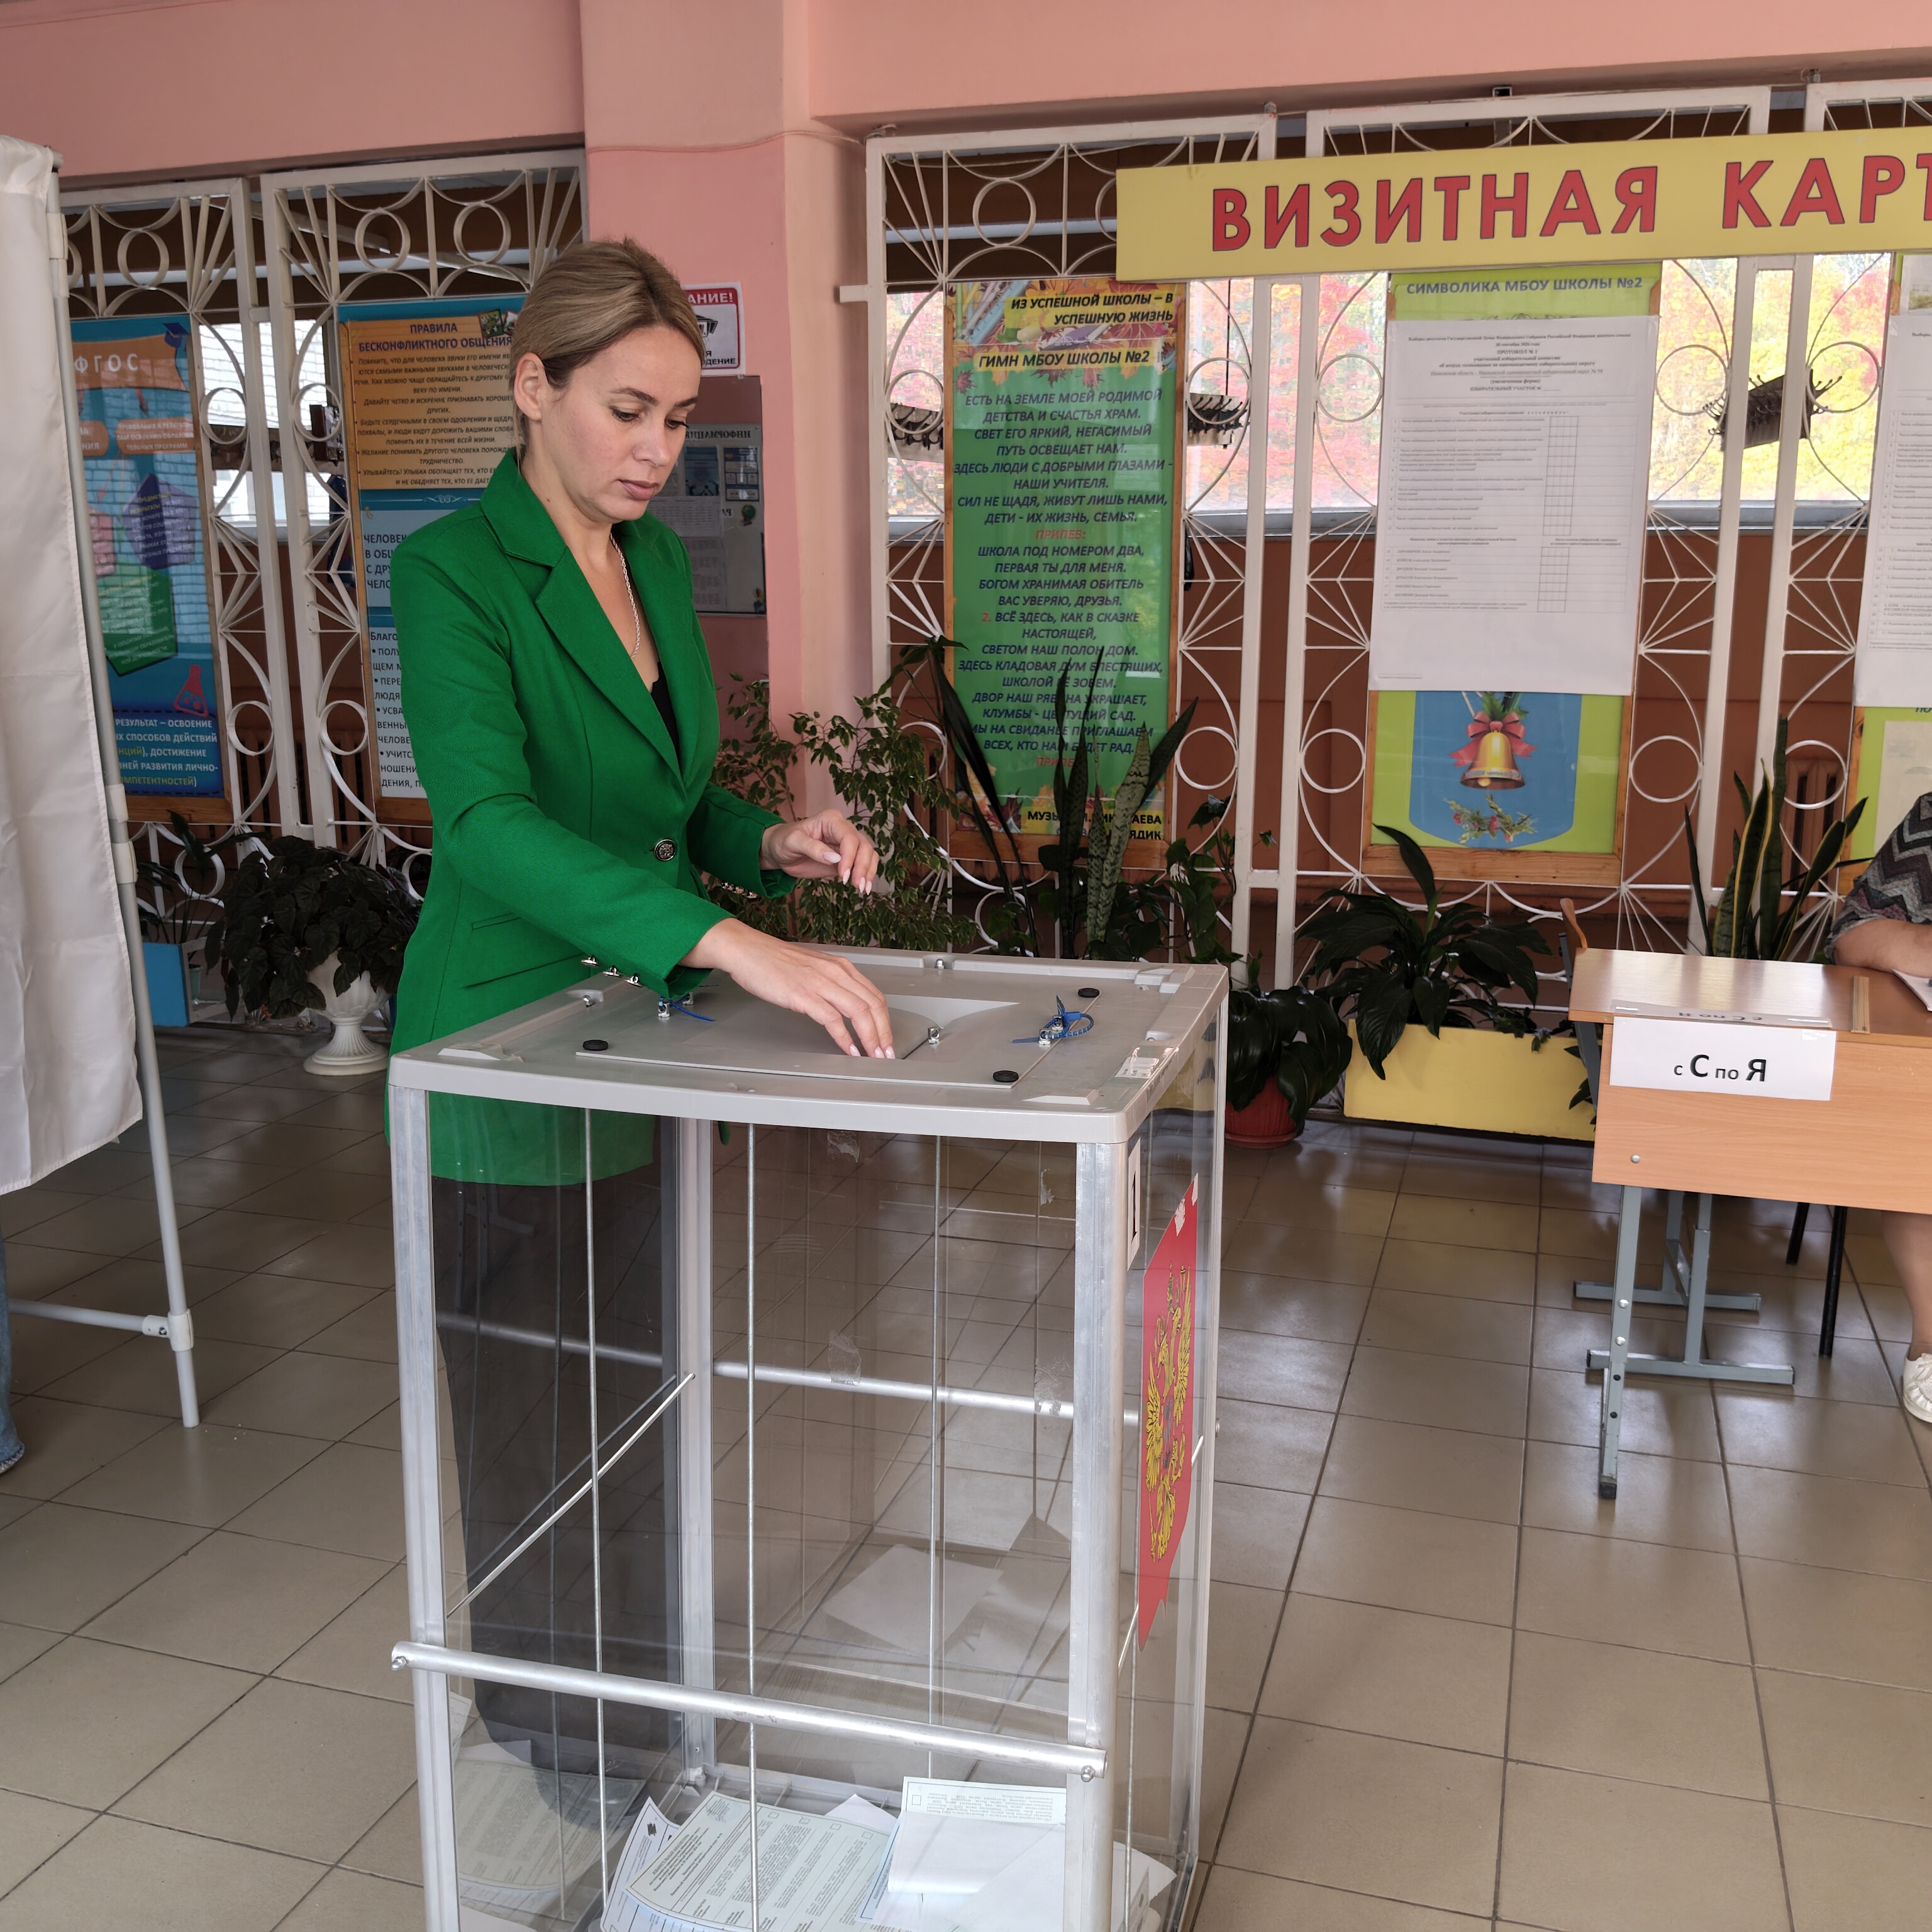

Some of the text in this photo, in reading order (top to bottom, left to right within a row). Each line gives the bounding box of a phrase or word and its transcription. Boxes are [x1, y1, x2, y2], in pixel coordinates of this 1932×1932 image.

[1212, 166, 1658, 252] ВИЗИТНАЯ
[1406, 277, 1643, 294] СИМВОЛИКА МБОУ ШКОЛЫ №2
[688, 292, 733, 304] АНИЕ!
[1011, 292, 1174, 309] ИЗ УСПЕШНОЙ ШКОЛЫ В
[1054, 310, 1174, 325] УСПЕШНУЮ ЖИЗНЬ
[410, 323, 458, 333] ПРАВИЛА
[358, 336, 512, 352] БЕСКОНФЛИКТНОГО ОБЩЕНИЯ
[979, 350, 1150, 369] ГИМН МБОУ ШКОЛЫ №2
[965, 389, 1162, 406] ЕСТЬ НА ЗЕМЛЕ МОЕЙ РОДИМОЙ
[982, 408, 1141, 424] ДЕТСТВА И СЧАСТЬЯ ХРАМ.
[974, 423, 1152, 440] СВЕТ ЕГО ЯРКИЙ, НЕГАСИМЫЙ
[996, 443, 1127, 457] ПУТЬ ОСВЕЩАЕТ НАМ.
[953, 460, 1165, 475] ЗДЕСЬ ЛЮДИ С ДОБРЫМИ ГЛАЗАМИ
[1013, 478, 1109, 489] НАШИ УЧИТЕЛЯ.
[957, 494, 1168, 508] СИЛ НЕ ЩАДЯ, ЖИВУТ ЛИШЬ НАМИ,
[984, 511, 1137, 525] ДЕТИ ИХ ЖИЗНЬ, СЕМЬЯ.
[365, 550, 371, 558] В
[977, 545, 1145, 558] ШКОЛА ПОД НОМЕРОМ ДВА,
[994, 563, 1126, 574] ПЕРВАЯ ТЫ ДЛЯ МЕНЯ.
[979, 579, 1144, 590] БОГОМ ХРАНИМАЯ ОБИТЕЛЬ
[998, 596, 1123, 608] ВАС УВЕРЯЮ, ДРУЗЬЯ.
[995, 611, 1017, 623] ВСЁ
[1018, 612, 1057, 625] ЗДЕСЬ,
[1060, 613, 1083, 623] КАК
[1086, 613, 1094, 623] В
[1097, 613, 1140, 623] СКАЗКЕ
[370, 632, 397, 641] БЛАГО
[1022, 628, 1097, 640] НАСТОЯЩЕЙ,
[982, 645, 1028, 655] СВЕТОМ
[1031, 645, 1058, 655] НАШ
[1105, 645, 1138, 657] ДОМ.
[958, 660, 992, 672] ЗДЕСЬ
[995, 661, 1057, 673] КЛАДОВАЯ
[380, 677, 401, 686] ПЕРЕ
[1002, 676, 1053, 687] ШКОЛОЙ
[972, 693, 1004, 704] ДВОР
[1006, 693, 1033, 703] НАШ
[1036, 694, 1081, 704] РЯБНА
[382, 707, 403, 715] УСВА
[983, 709, 1136, 722] КЛУМБЫ ЦВТУЩИЙ САД.
[168, 720, 213, 728] ОСВОЕНИЕ
[377, 721, 407, 730] ВЕННЫ
[991, 724, 1006, 734] НА
[126, 733, 218, 743] СПОСОБОВ ДЕЙСТВИЙ
[379, 736, 410, 744] ЧЕЛОВЕ
[118, 746, 207, 757] НЦИЙ), ДОСТИЖЕНИЕ
[984, 740, 1013, 751] ВСЕХ,
[1017, 741, 1038, 751] КТО
[1109, 743, 1134, 754] РАД.
[386, 750, 414, 759] УЧИТС
[141, 762, 183, 771] РАЗВИТИЯ
[1674, 1054, 1767, 1082] с С по Я
